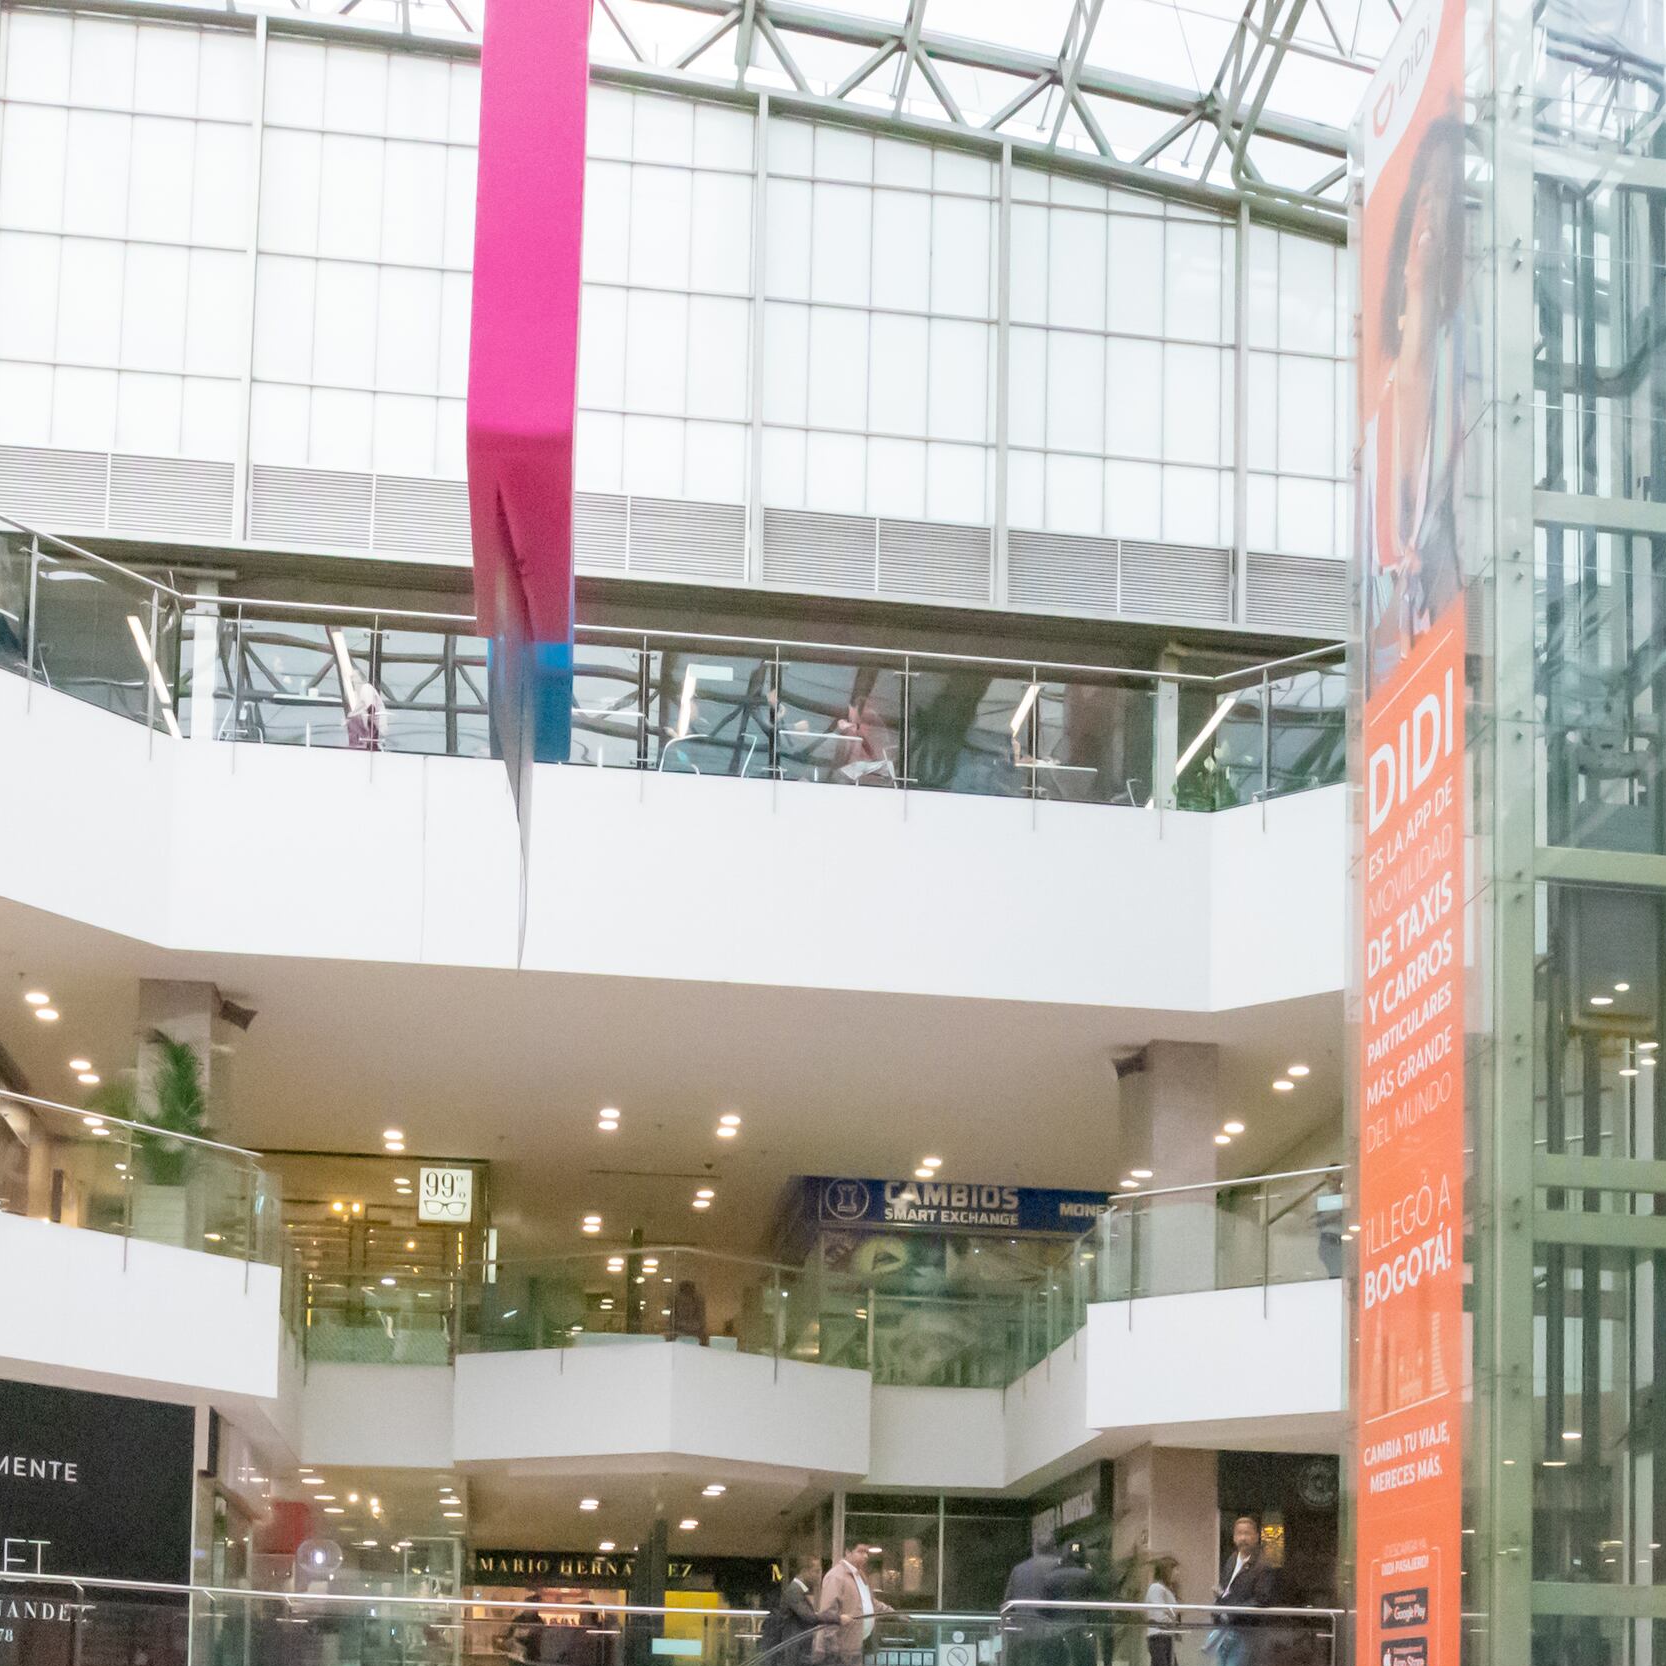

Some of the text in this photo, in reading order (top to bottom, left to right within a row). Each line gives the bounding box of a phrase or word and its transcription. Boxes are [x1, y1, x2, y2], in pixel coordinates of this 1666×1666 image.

[1369, 667, 1453, 836] DIDI
[1369, 776, 1453, 883] ES LA APP DE
[1369, 823, 1453, 930] MOVILIDAD
[1368, 871, 1453, 980] DE TAXIS
[1368, 928, 1453, 1027] Y CARROS
[1367, 981, 1453, 1067] PARTICULARES
[1366, 1024, 1453, 1111] MÁS GRANDE
[1366, 1071, 1452, 1155] DEL MUNDO
[884, 1182, 1020, 1211] CAMBIOS
[884, 1210, 1019, 1227] SMART EXCHANGE
[1438, 1174, 1451, 1217] A
[1365, 1223, 1452, 1310] BOGOTÁ!
[1363, 1434, 1402, 1467] CAMBIA
[1404, 1431, 1418, 1455] TU
[1369, 1462, 1415, 1494] MERECES
[479, 1557, 693, 1579] MARIO HERNAEZ
